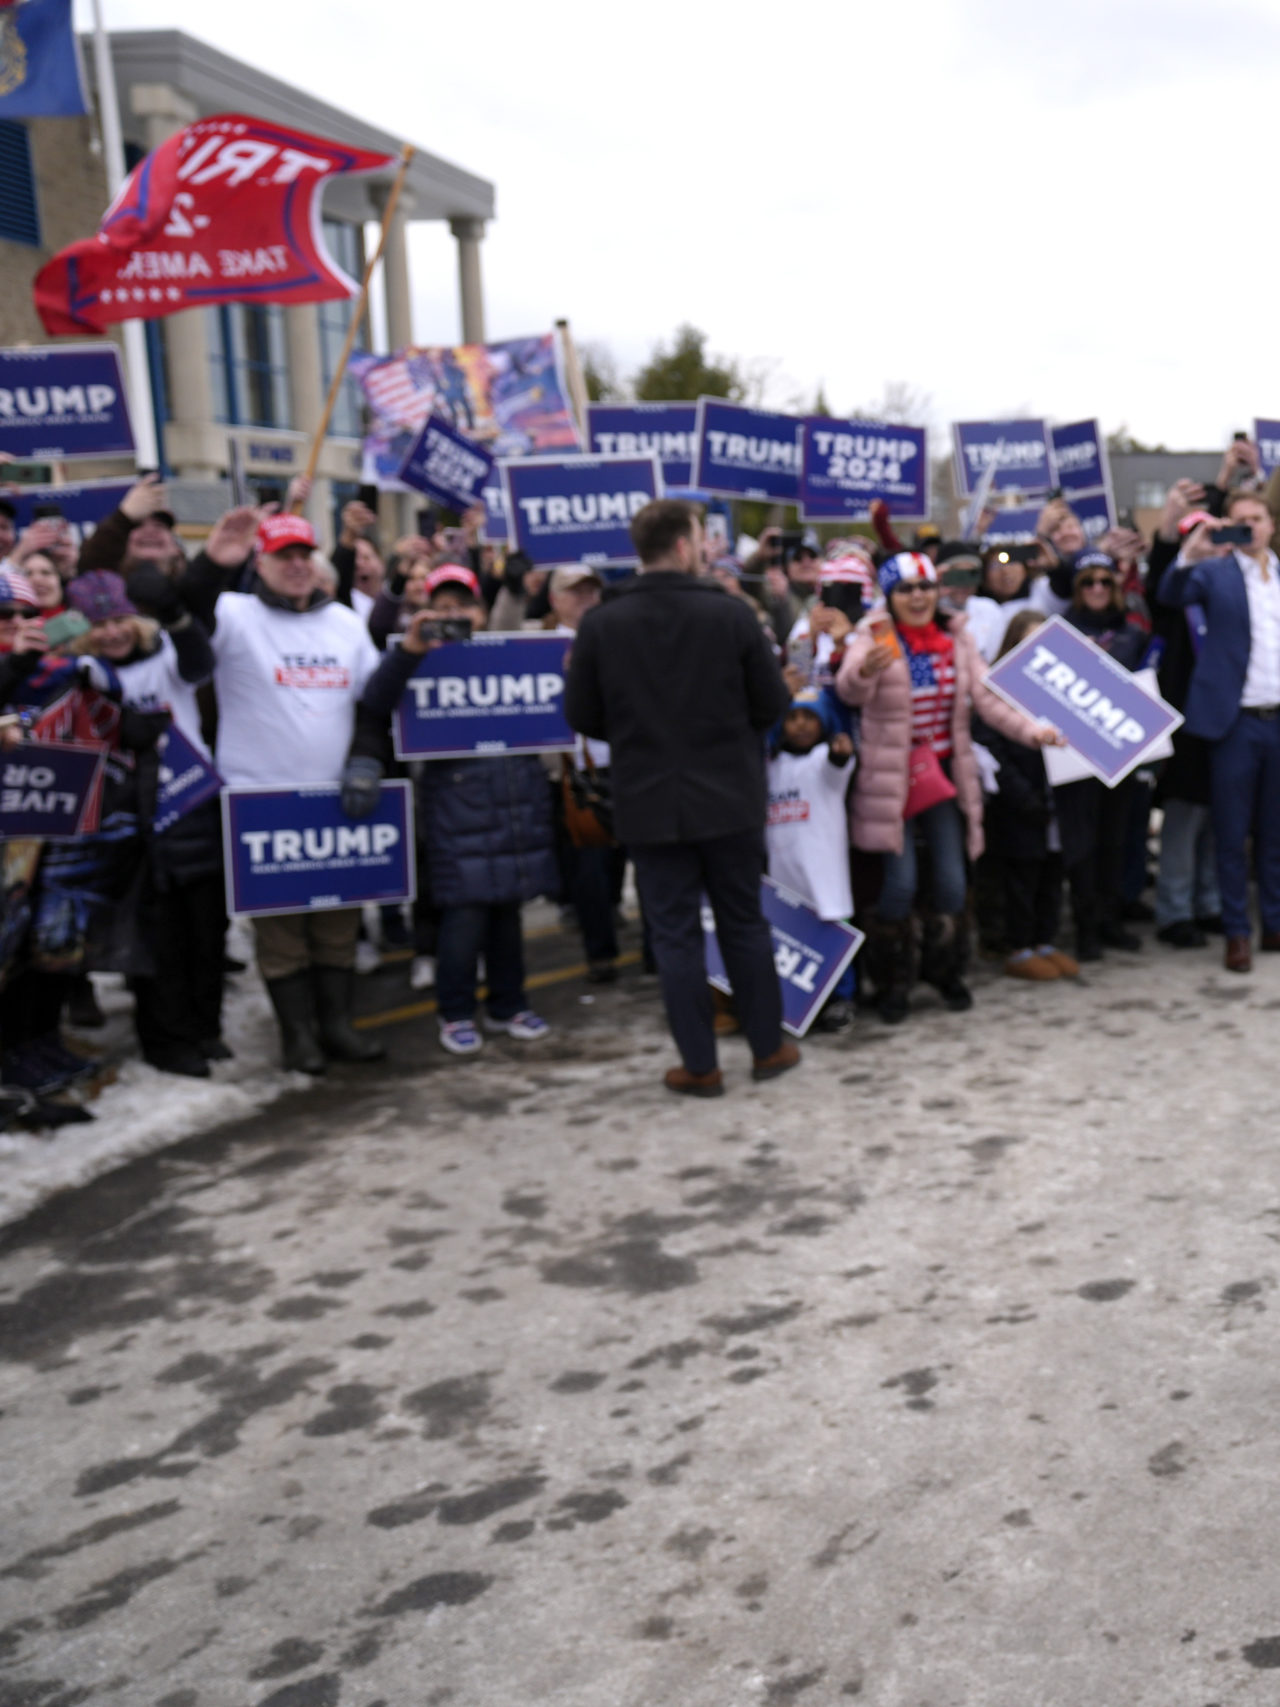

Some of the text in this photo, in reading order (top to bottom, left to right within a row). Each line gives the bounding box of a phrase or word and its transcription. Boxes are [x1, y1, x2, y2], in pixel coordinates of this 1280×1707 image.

[0, 384, 116, 417] RUMP
[594, 431, 698, 457] TRUM
[706, 430, 803, 466] TRUM
[812, 432, 917, 463] TRUMP
[826, 456, 902, 483] 2024
[519, 490, 651, 526] TRUMP
[407, 673, 565, 709] TRUMP
[1029, 645, 1146, 744] TRUMP
[3, 764, 55, 788] OR
[0, 789, 78, 814] LIVE
[241, 823, 399, 864] TRUMP
